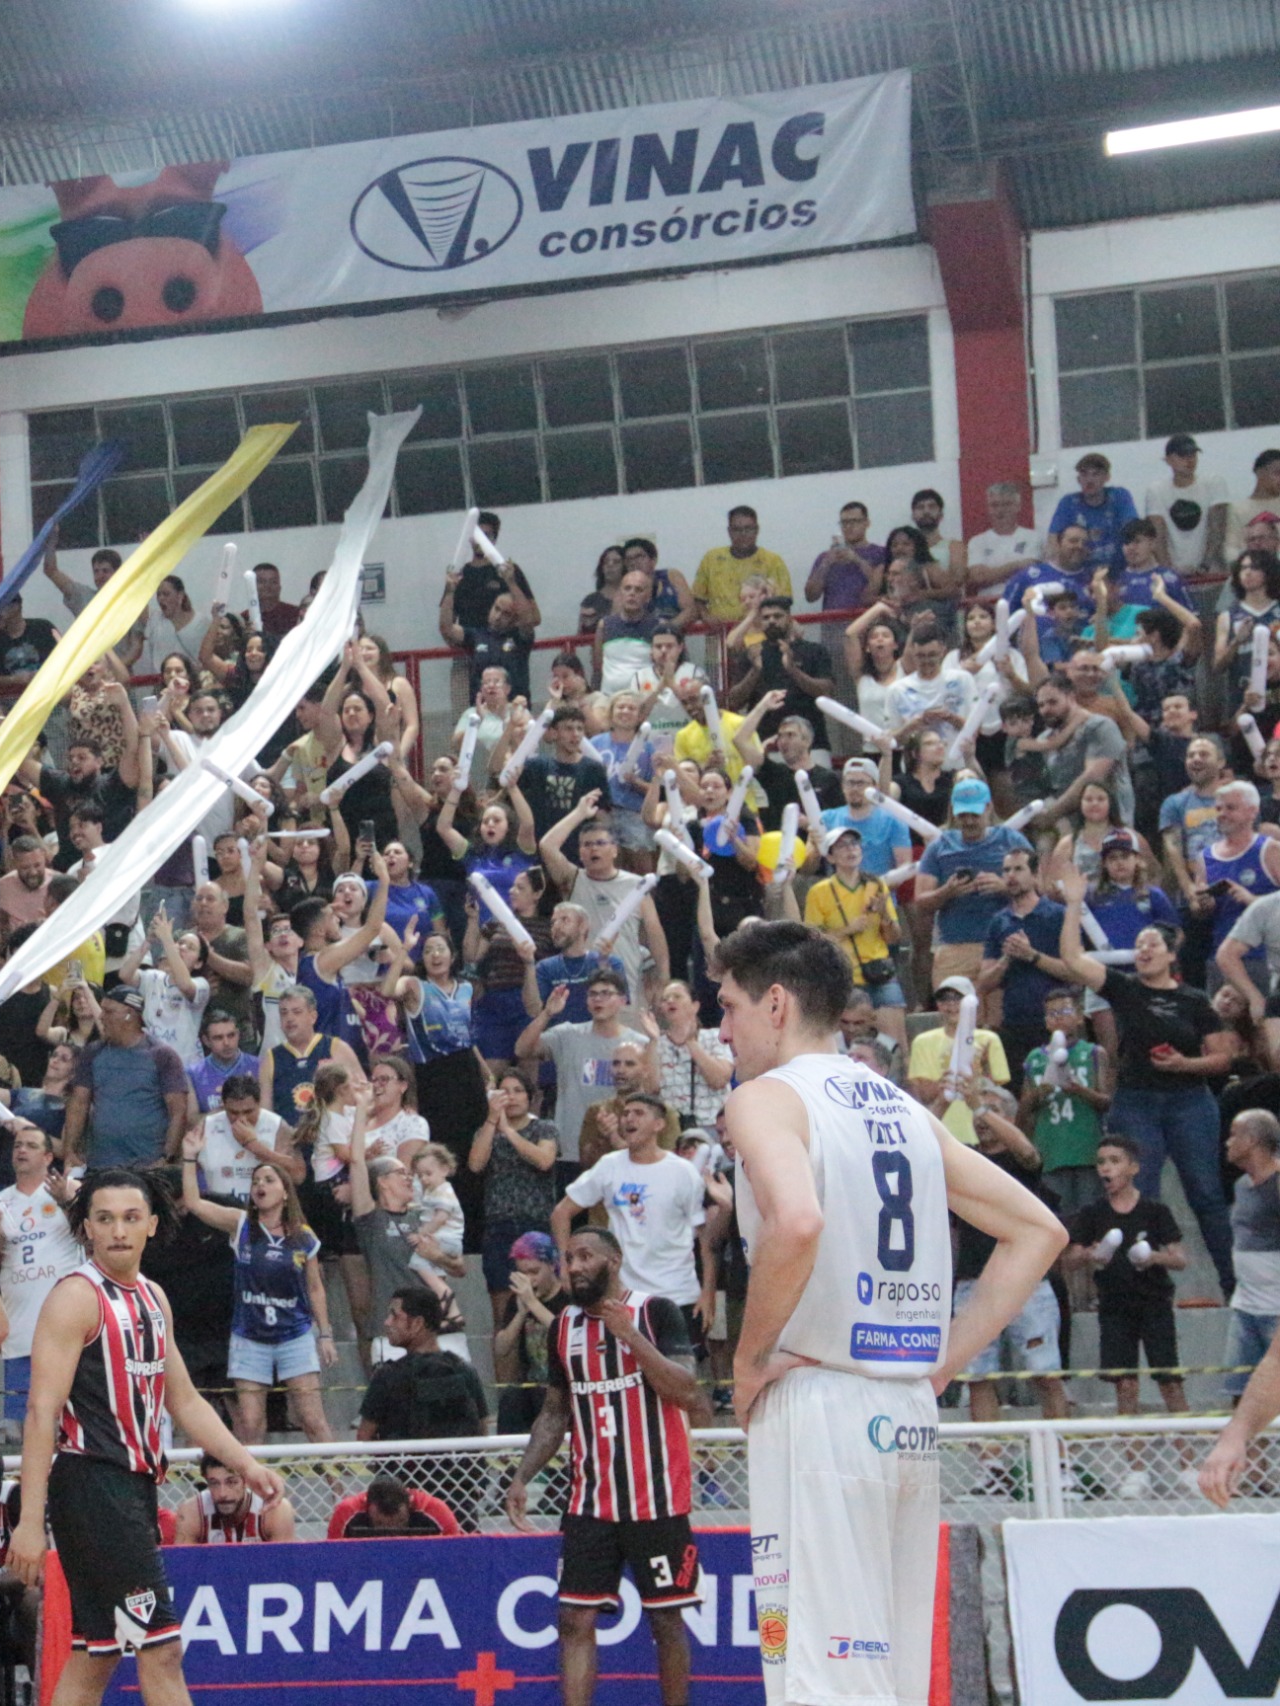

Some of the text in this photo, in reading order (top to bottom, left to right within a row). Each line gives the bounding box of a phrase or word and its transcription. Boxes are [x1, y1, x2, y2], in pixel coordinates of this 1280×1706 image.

[526, 111, 826, 212] VINAC
[538, 197, 818, 258] consórcios
[1048, 1098, 1075, 1125] 34
[871, 1149, 915, 1272] 8
[22, 1245, 35, 1265] 2
[10, 1265, 57, 1285] OSCAR
[877, 1278, 941, 1308] raposo
[264, 1305, 278, 1326] 8
[856, 1329, 898, 1348] FARMA
[571, 1371, 643, 1395] SUPERBET
[598, 1405, 618, 1438] 3
[650, 1554, 674, 1588] 3
[168, 1578, 463, 1656] ARMA
